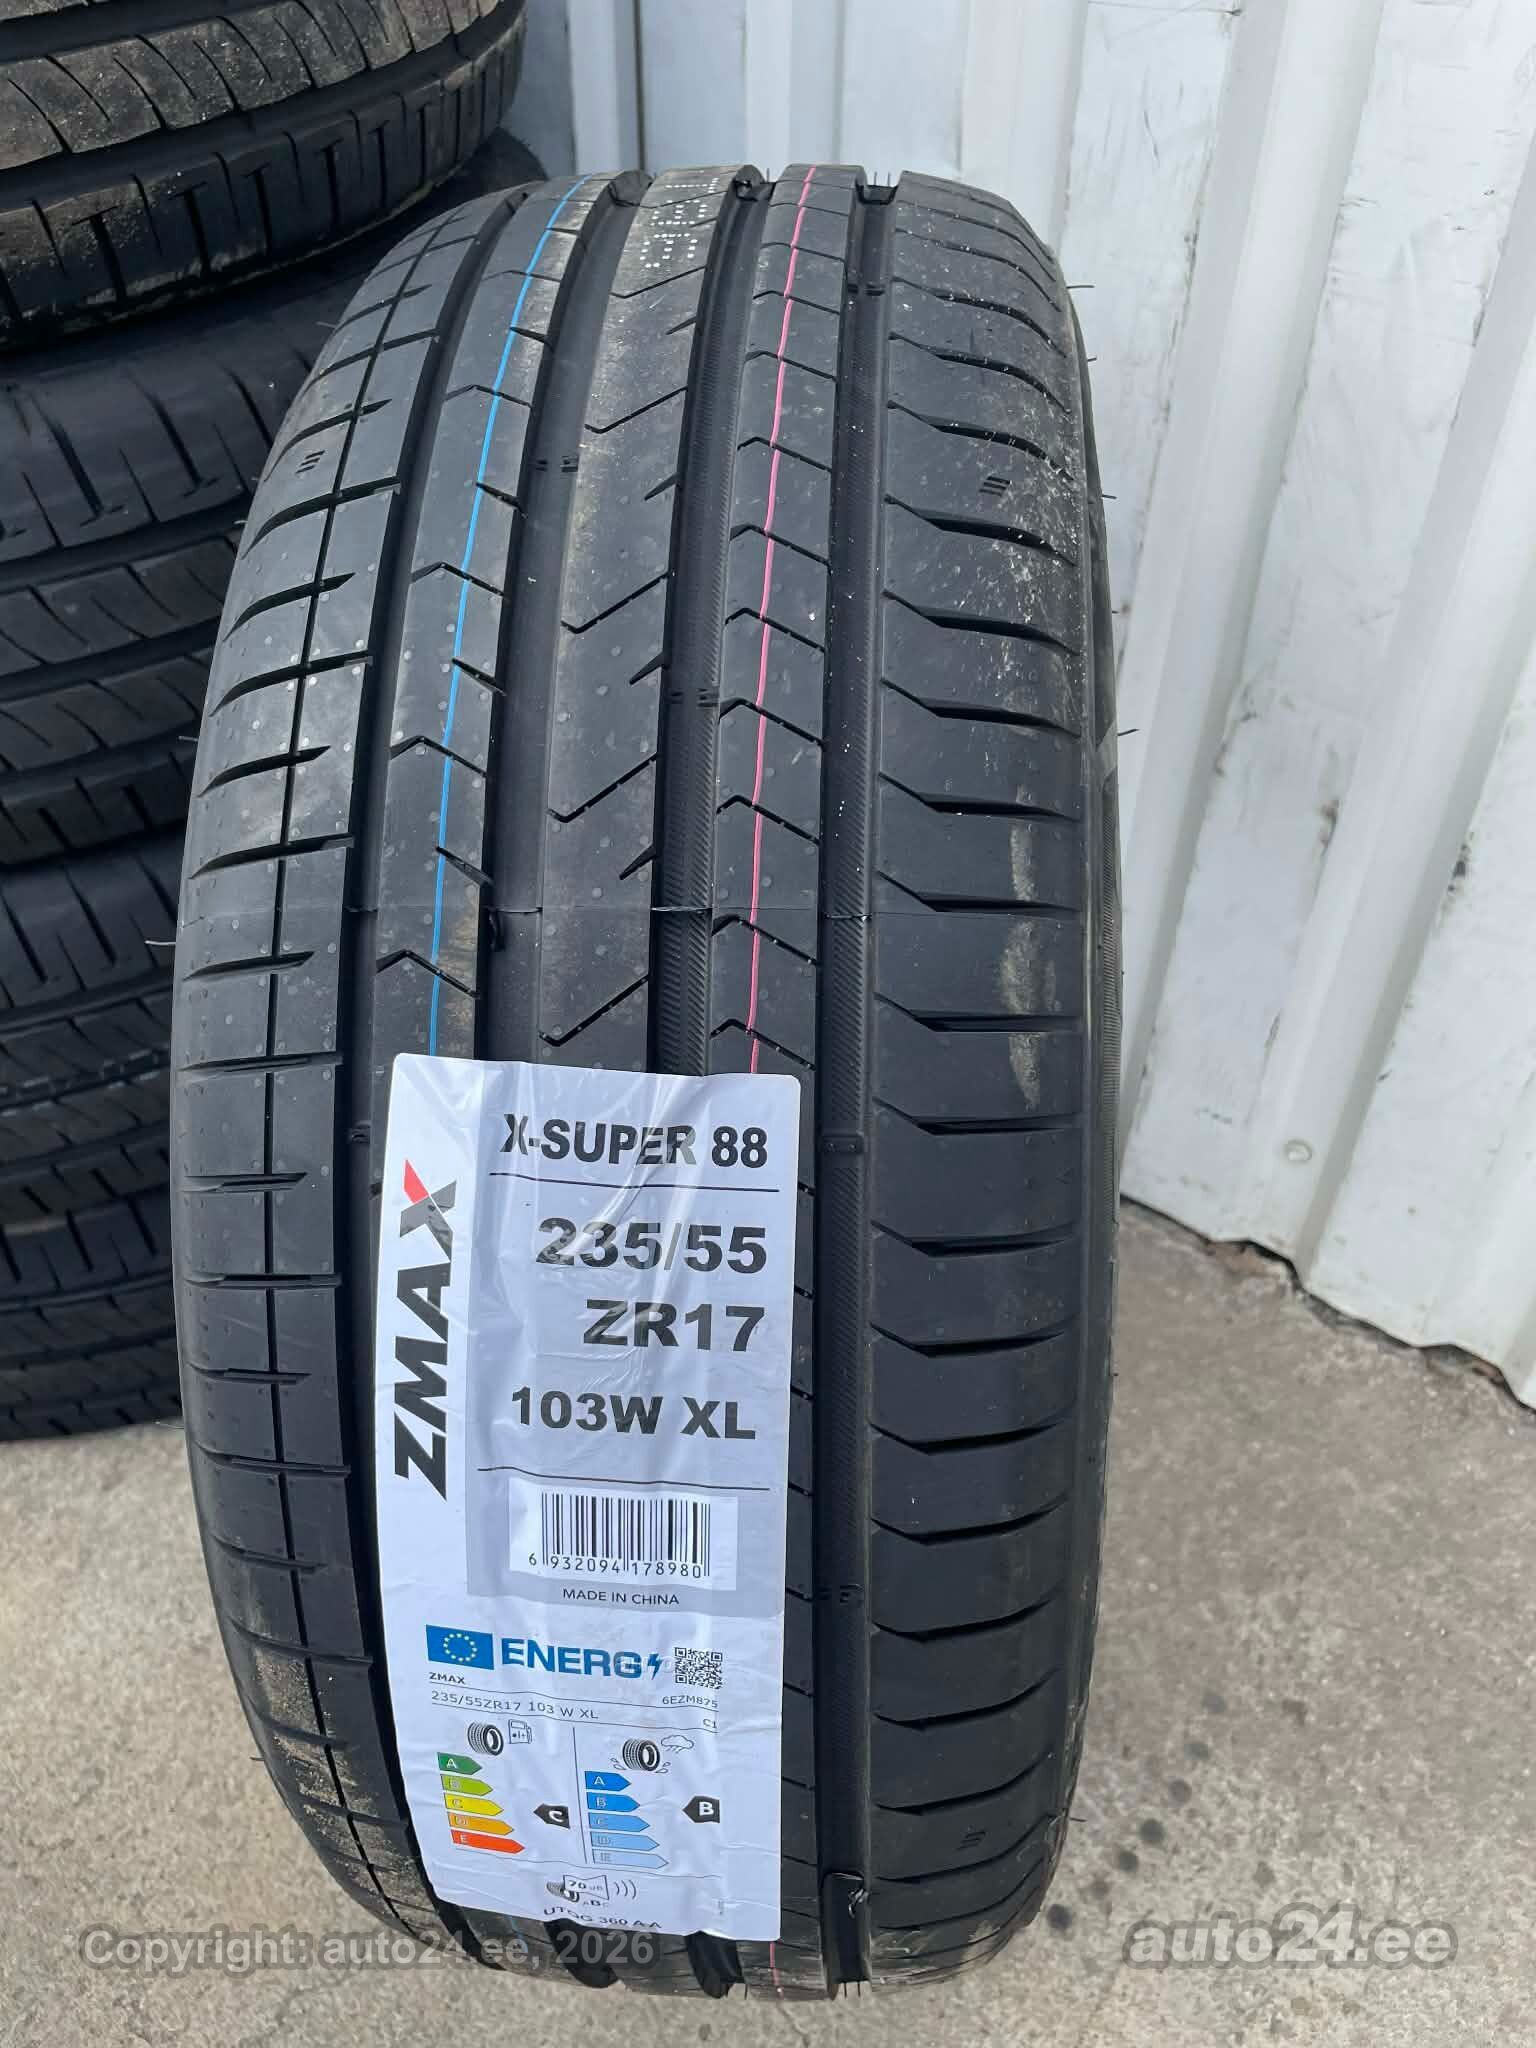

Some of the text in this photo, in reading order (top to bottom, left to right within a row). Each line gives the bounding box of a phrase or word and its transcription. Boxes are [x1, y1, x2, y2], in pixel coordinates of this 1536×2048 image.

[500, 1113, 768, 1169] X-SUPER 88
[536, 1217, 767, 1274] 235/55
[394, 1158, 457, 1501] ZMAX
[583, 1299, 765, 1352] ZR17
[512, 1387, 756, 1439] 103W XL
[562, 1588, 680, 1605] MADE IN CHINA
[501, 1638, 642, 1679] ENERG
[429, 1671, 466, 1684] ZMAX
[431, 1690, 600, 1719] 235/55ZR17 103 W XL
[446, 1758, 457, 1769] A
[593, 1775, 605, 1785] A
[548, 1810, 564, 1823] C
[699, 1801, 714, 1816] B
